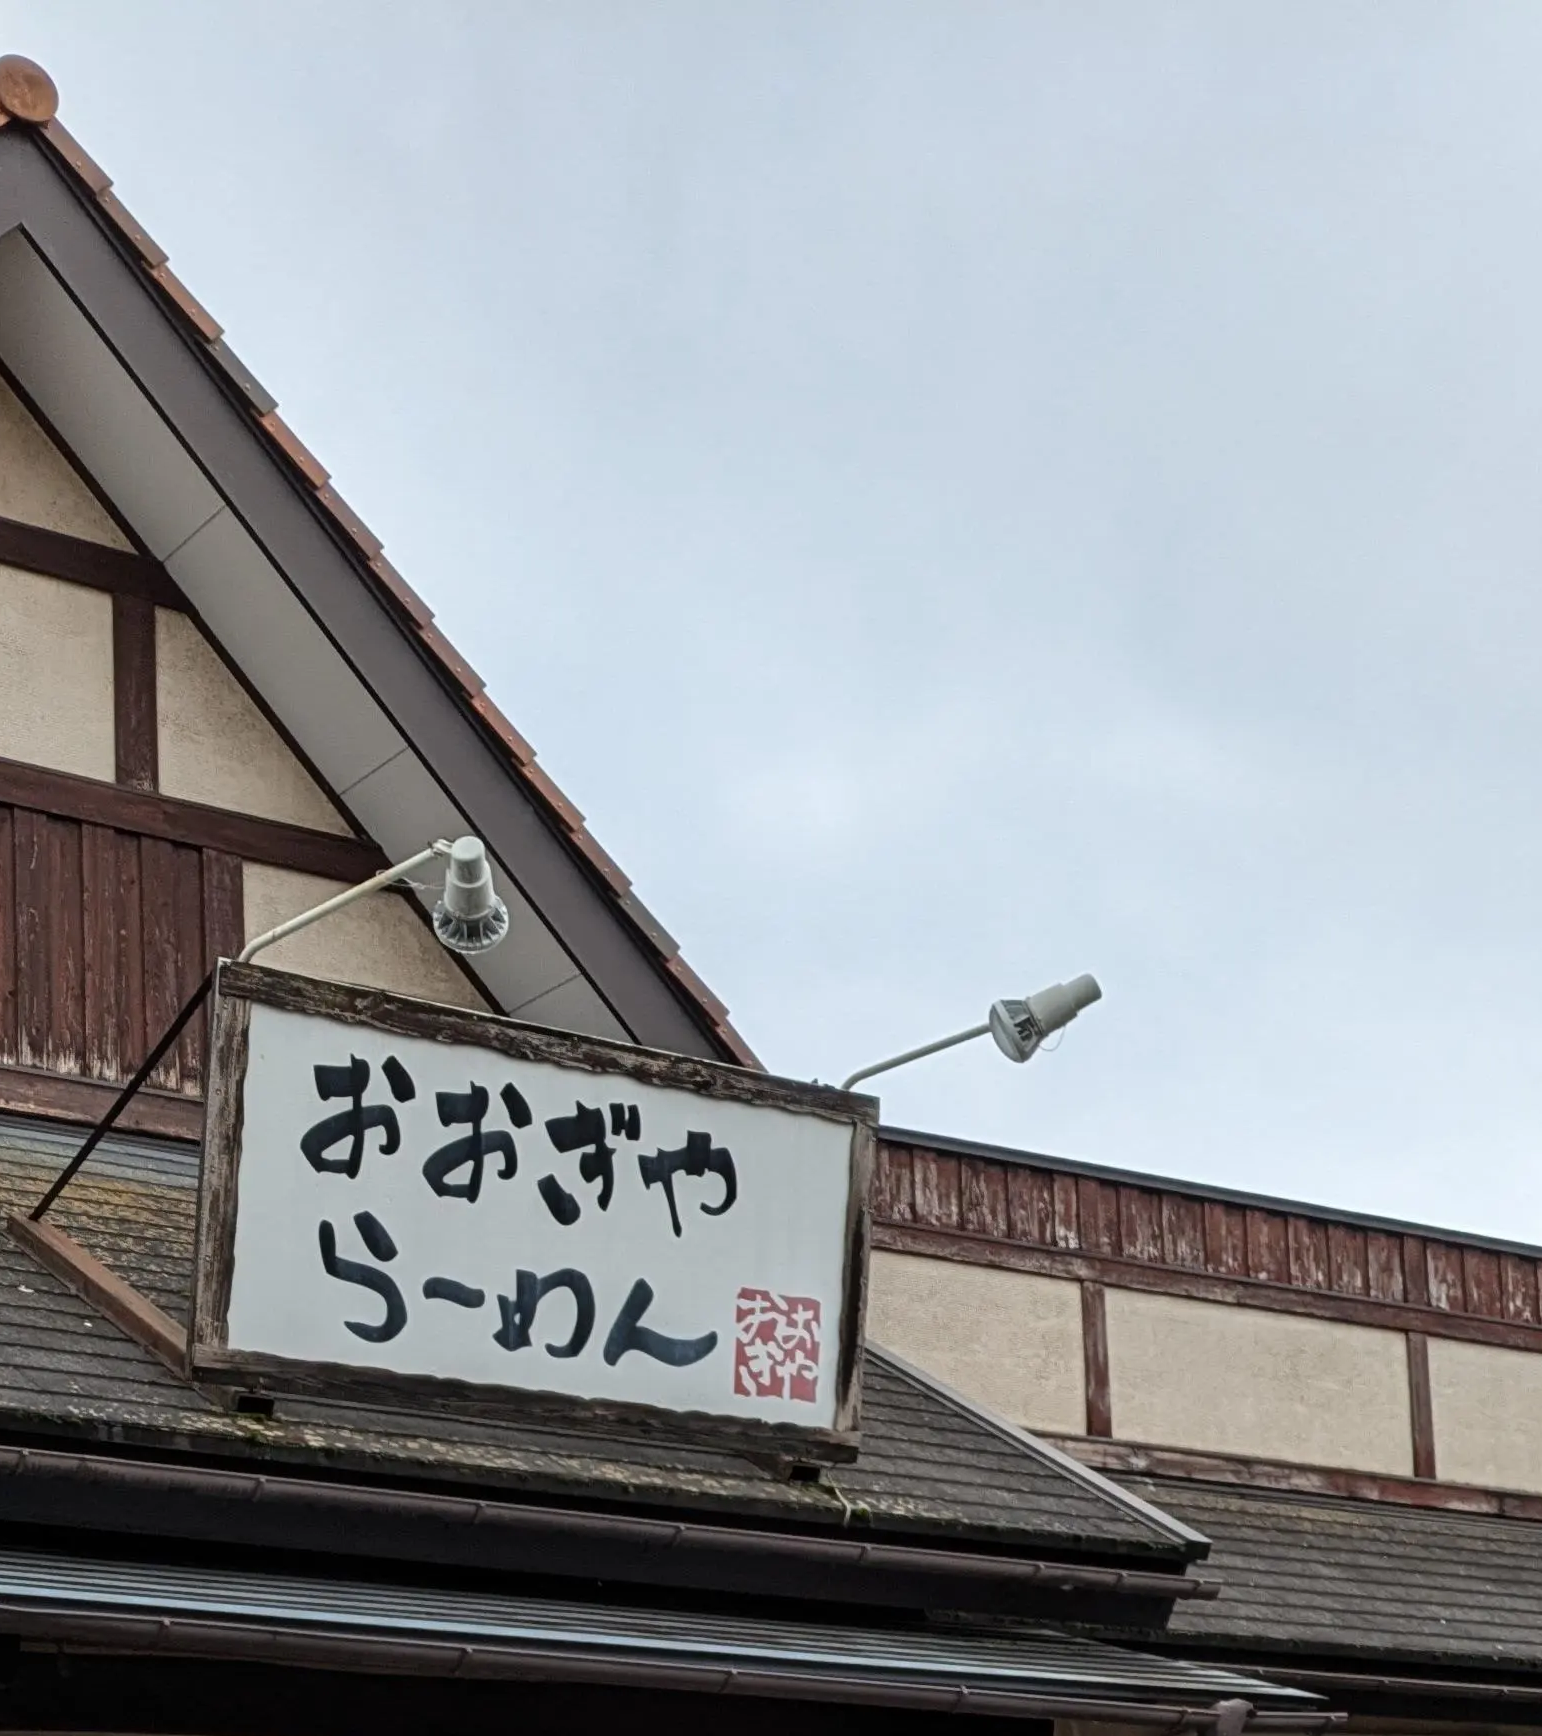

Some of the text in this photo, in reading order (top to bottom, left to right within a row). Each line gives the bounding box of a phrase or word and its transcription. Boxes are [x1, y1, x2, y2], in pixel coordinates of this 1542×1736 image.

[300, 1055, 738, 1238] おおぎや
[318, 1210, 718, 1367] らーめん
